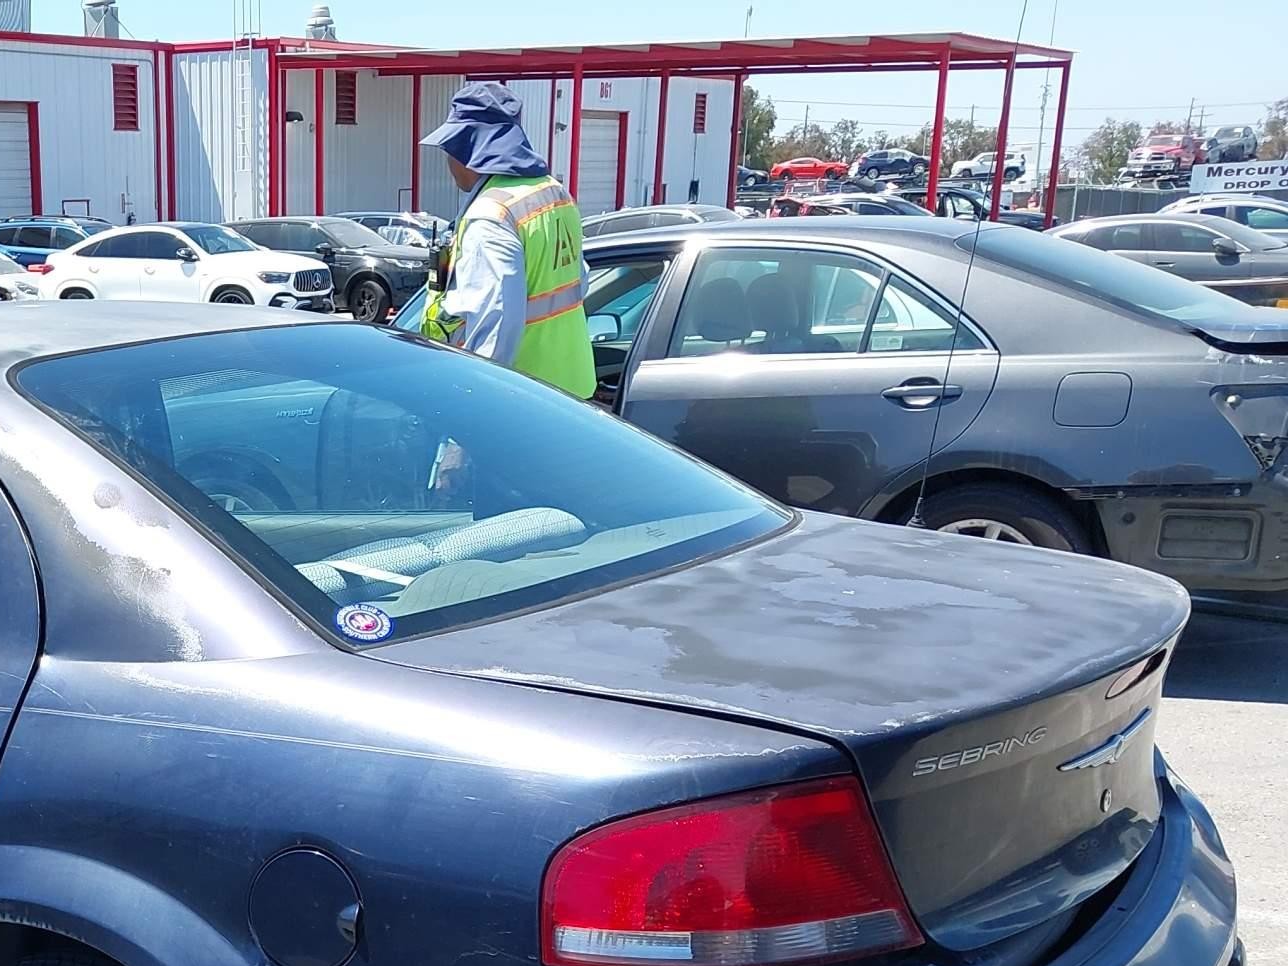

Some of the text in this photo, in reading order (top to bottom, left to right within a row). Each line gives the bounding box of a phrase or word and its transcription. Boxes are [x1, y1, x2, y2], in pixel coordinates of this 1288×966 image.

[1206, 165, 1288, 178] Mercury
[1223, 180, 1272, 190] DROP
[912, 726, 1048, 777] SEBRING
